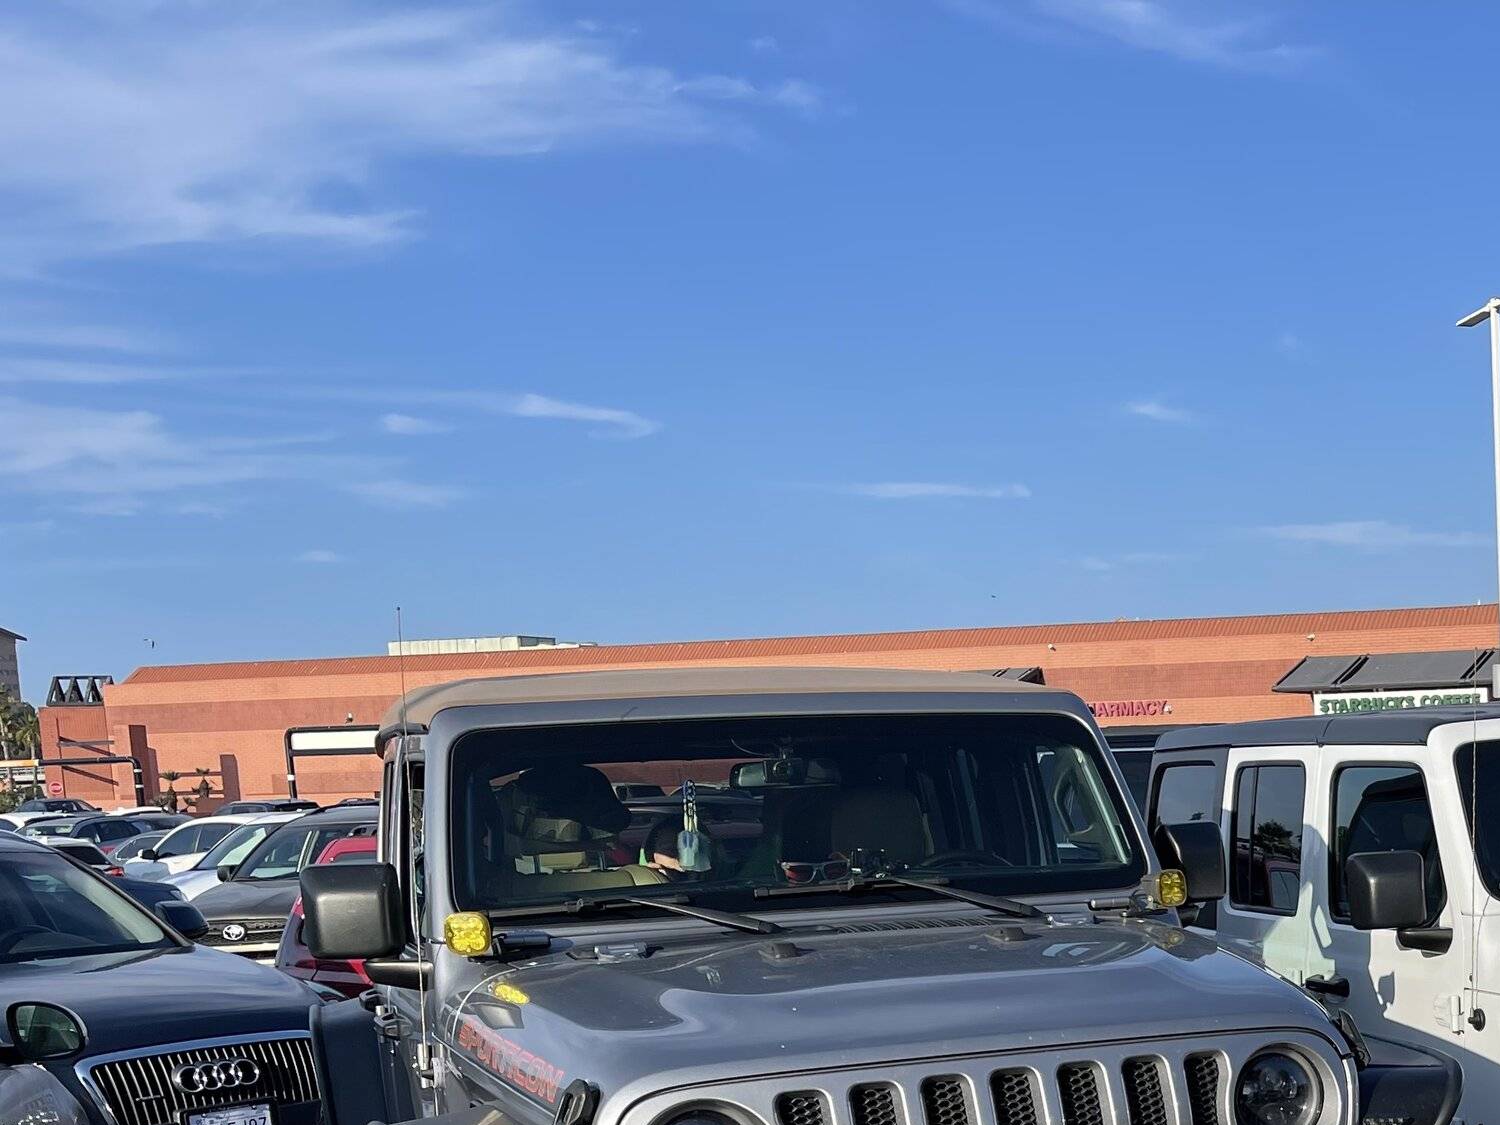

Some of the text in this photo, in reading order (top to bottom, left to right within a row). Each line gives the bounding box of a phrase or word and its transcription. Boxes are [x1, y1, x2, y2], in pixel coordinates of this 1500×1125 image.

[1087, 700, 1168, 717] HARMACY
[1319, 693, 1481, 714] STARBUCKS COFFEE
